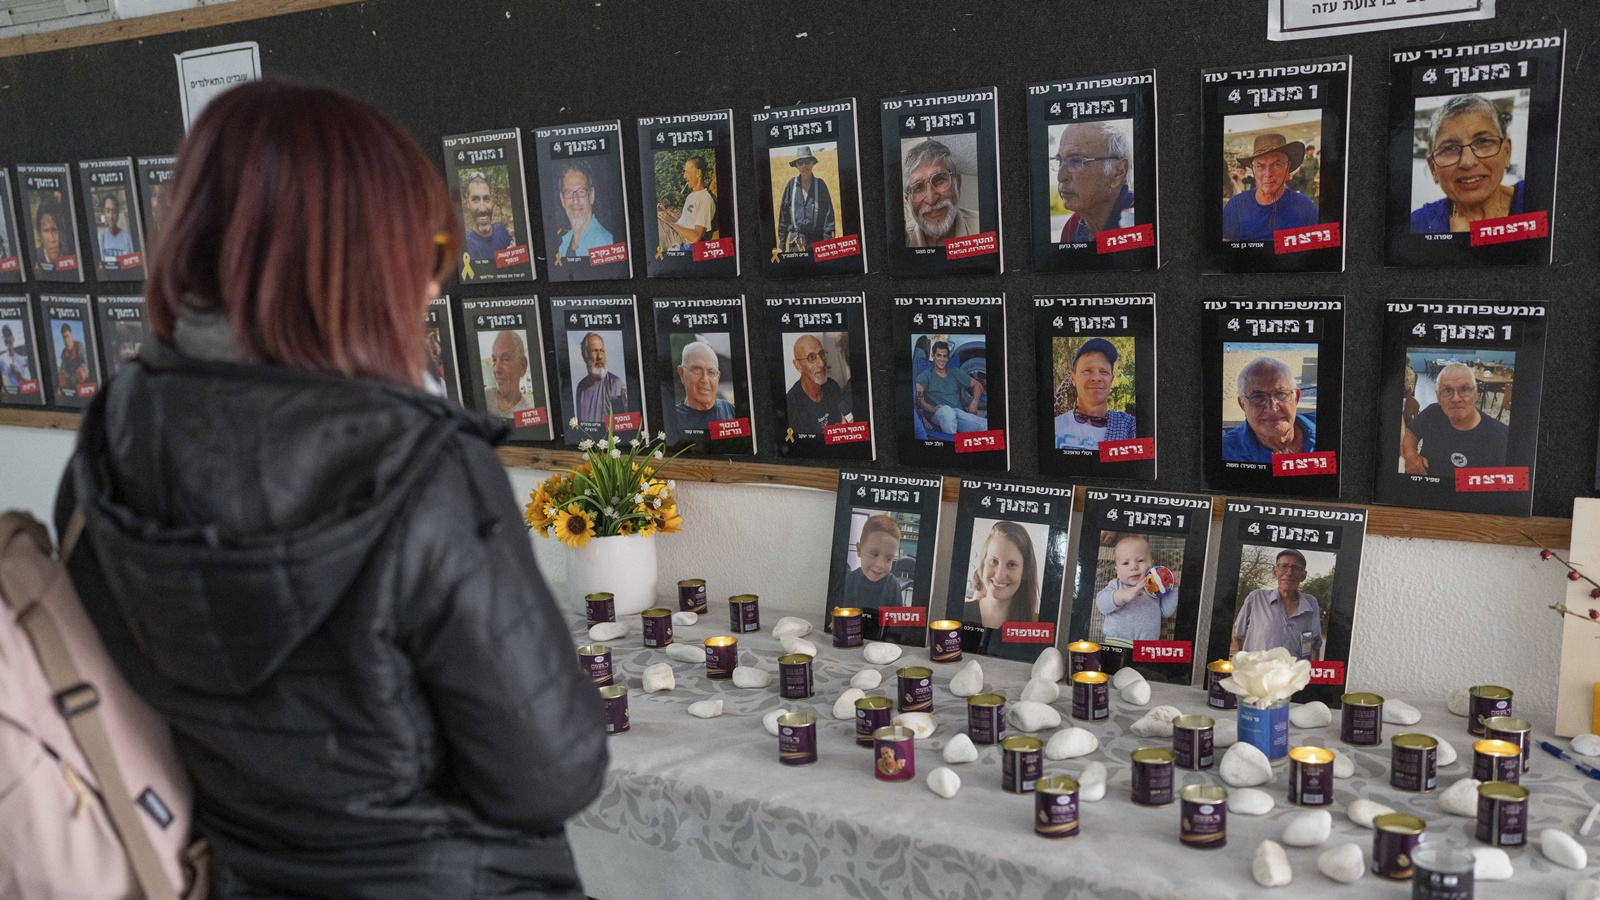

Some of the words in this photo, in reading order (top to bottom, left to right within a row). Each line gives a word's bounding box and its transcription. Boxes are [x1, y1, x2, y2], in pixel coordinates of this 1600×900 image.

[1312, 2, 1337, 14] עזה
[1457, 35, 1561, 55] ממשפחת
[1393, 50, 1421, 63] עוז
[1424, 49, 1451, 60] ניר
[1230, 69, 1255, 79] ניר
[1258, 61, 1346, 78] ממשפחת
[1445, 63, 1509, 86] מתוך
[1518, 61, 1528, 77] 1
[191, 77, 224, 88] התאילנדים
[226, 74, 247, 83] עובדינו
[1076, 74, 1152, 91] ממשפחת
[1204, 72, 1227, 82] עוז
[1422, 69, 1437, 86] 4
[1029, 85, 1050, 95] עוז
[1053, 82, 1072, 92] ניר
[925, 91, 993, 104] ממשפחת
[1228, 89, 1240, 103] 4
[1248, 86, 1303, 107] מתוך
[790, 102, 851, 117] ממשפחת
[883, 100, 902, 110] עוז
[1050, 103, 1061, 116] 4
[1067, 100, 1114, 119] מתוך
[1120, 99, 1127, 112] 1
[673, 112, 728, 122] ממשפחת
[752, 112, 769, 122] עוז
[772, 111, 787, 119] ניר
[968, 112, 975, 124] 1
[906, 116, 915, 129] 4
[920, 113, 964, 132] מתוך
[568, 124, 618, 135] ממשפחת
[770, 126, 779, 137] 4
[783, 122, 822, 140] מתוך
[472, 132, 516, 142] ממשפחת
[656, 132, 665, 144] 4
[668, 131, 703, 146] מתוך
[564, 140, 596, 155] מתוך
[467, 150, 496, 164] מתוך
[1480, 220, 1536, 237] נרצחה
[838, 240, 856, 248] נחטף
[973, 237, 994, 245] נחטף
[1107, 232, 1142, 246] נרצח
[1284, 230, 1331, 246] נרצח
[815, 243, 836, 253] ונרצח
[949, 240, 971, 249] ונרצח
[590, 248, 609, 258] בקרב
[704, 249, 724, 258] בקרב
[766, 298, 782, 306] עוז
[803, 295, 862, 305] ממשפחת
[915, 297, 933, 305] ניר
[936, 297, 1002, 305] ממשפחת
[1034, 298, 1054, 307] עוז
[1057, 298, 1076, 306] ניר
[1080, 295, 1153, 305] ממשפחת
[1204, 301, 1227, 310] עוז
[1230, 301, 1253, 310] ניר
[1256, 301, 1341, 310] ממשפחת
[1386, 303, 1414, 313] עוז
[1417, 304, 1444, 314] ניר
[1447, 305, 1545, 316] ממשפחת
[488, 315, 514, 328] מתוך
[581, 314, 611, 327] מתוך
[684, 314, 718, 328] מתוך
[794, 314, 831, 327] מתוך
[913, 313, 923, 324] 4
[928, 314, 970, 329] מתוך
[1053, 316, 1063, 329] 4
[1069, 316, 1116, 333] מתוך
[1227, 318, 1239, 332] 4
[1247, 318, 1299, 336] מתוך
[1412, 322, 1426, 337] 4
[1433, 324, 1494, 342] מתוך
[1502, 326, 1512, 340] 1
[719, 421, 739, 429] נחטף
[963, 436, 994, 447] נרצח
[1109, 445, 1144, 456] נרצח
[1282, 458, 1327, 470] נרצח
[841, 472, 858, 481] עוז
[862, 474, 879, 482] ניר
[880, 476, 940, 487] ממשפחת
[1468, 474, 1514, 485] נרצח
[962, 479, 981, 489] עוז
[984, 481, 1002, 490] ניר
[1004, 484, 1071, 496] ממשפחת
[856, 486, 866, 498] 4
[871, 487, 909, 503] מתוך
[1087, 490, 1108, 500] עוז
[1112, 493, 1132, 502] ניר
[981, 496, 991, 508] 4
[997, 498, 1039, 514] מתוך
[1134, 495, 1210, 509] ממשפחת
[1228, 502, 1250, 513] עוז
[1107, 509, 1118, 521] 4
[1254, 504, 1277, 515] ניר
[1279, 507, 1363, 522] ממשפחת
[1124, 511, 1170, 527] מתוך
[1248, 522, 1260, 535] 4
[1266, 525, 1318, 542] מתוך
[1007, 628, 1049, 638] חטופה!
[1141, 646, 1183, 659] חטוף!
